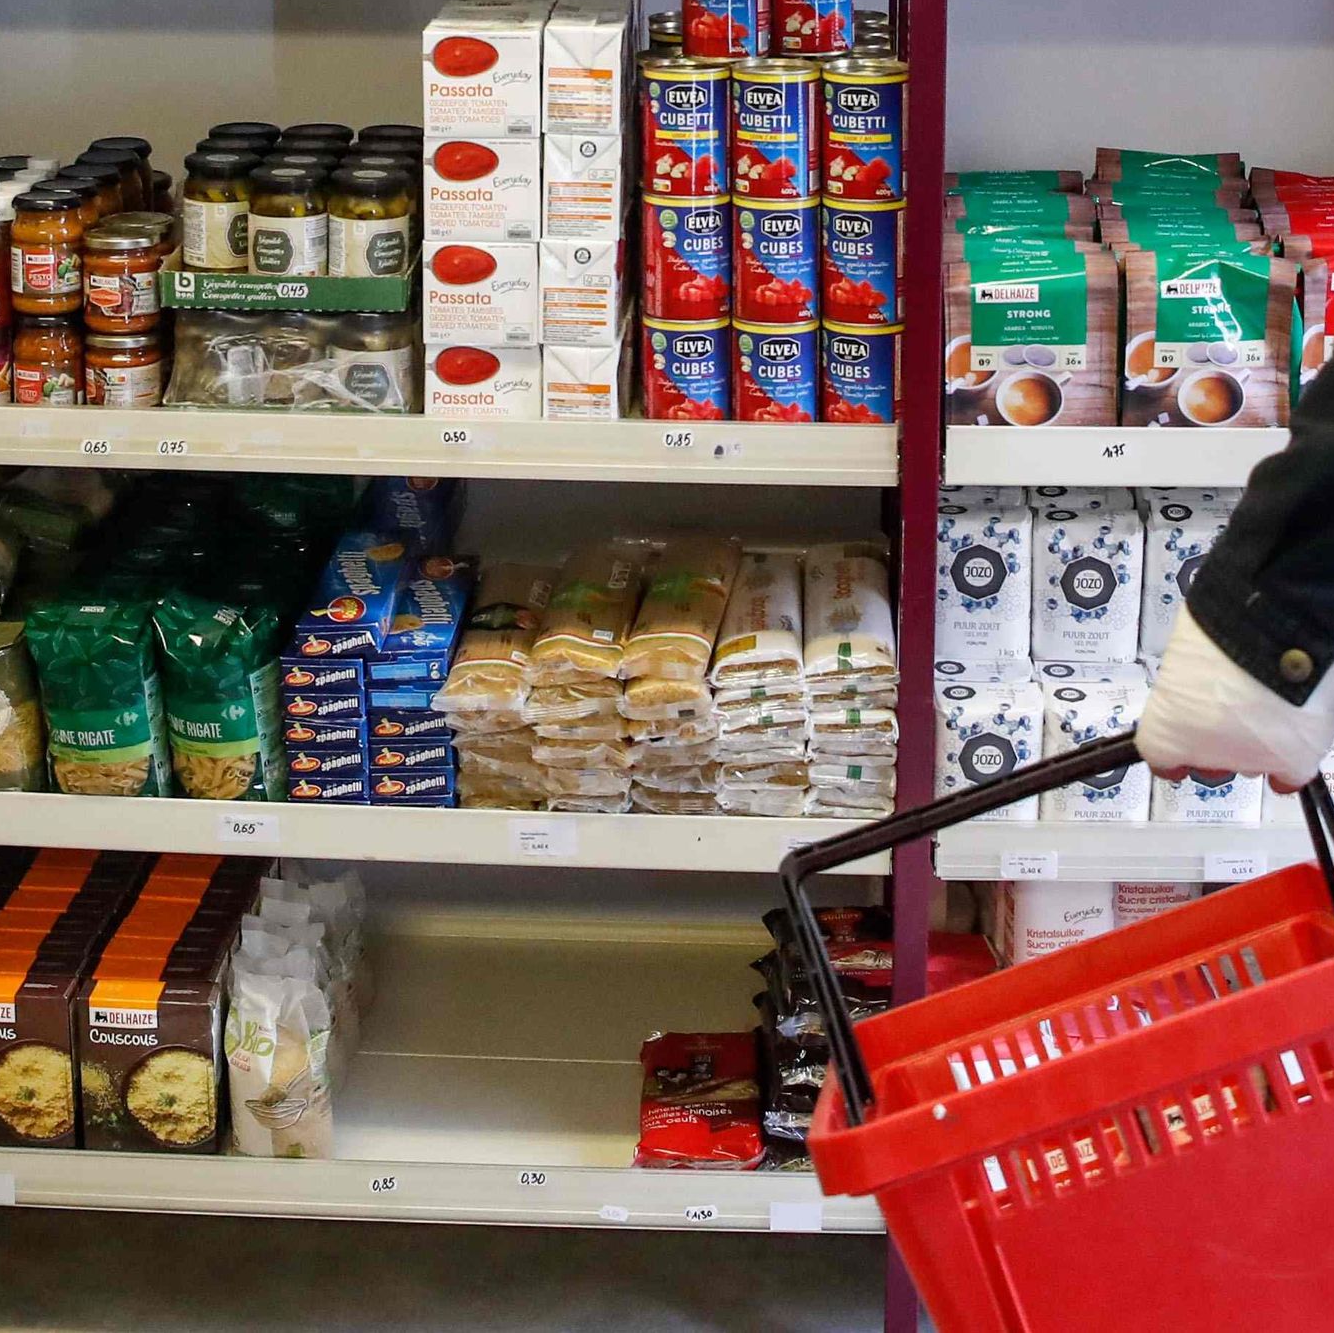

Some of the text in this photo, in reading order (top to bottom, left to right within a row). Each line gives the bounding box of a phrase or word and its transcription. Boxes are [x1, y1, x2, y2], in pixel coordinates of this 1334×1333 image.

[492, 70, 532, 84] Everyday
[429, 84, 493, 97] Passata
[840, 93, 877, 108] ELVEA
[740, 115, 791, 127] CUBETTI
[833, 115, 885, 128] CUBETTI
[431, 187, 493, 201] Passata
[760, 240, 802, 254] CUBES
[832, 241, 873, 255] CUBES
[429, 291, 491, 305] Passata
[994, 288, 1036, 299] DELHAIZE
[1007, 309, 1051, 318] STRONG
[666, 433, 693, 446] 0,85
[84, 441, 107, 453] 0,65
[161, 441, 184, 454] 0,75
[965, 566, 992, 580] JOZO
[75, 730, 114, 746] RIGATE
[322, 753, 361, 772] spaghetti
[975, 754, 1001, 766] JOZO
[233, 822, 255, 833] 0,65
[1119, 884, 1174, 893] Kristalsuiker
[1119, 895, 1146, 904] Sucre
[1064, 906, 1103, 922] Everyday
[109, 1011, 154, 1026] DELHAIZE
[89, 1029, 157, 1045] Couscous
[372, 1177, 394, 1192] 0,85
[521, 1172, 545, 1185] 0,30
